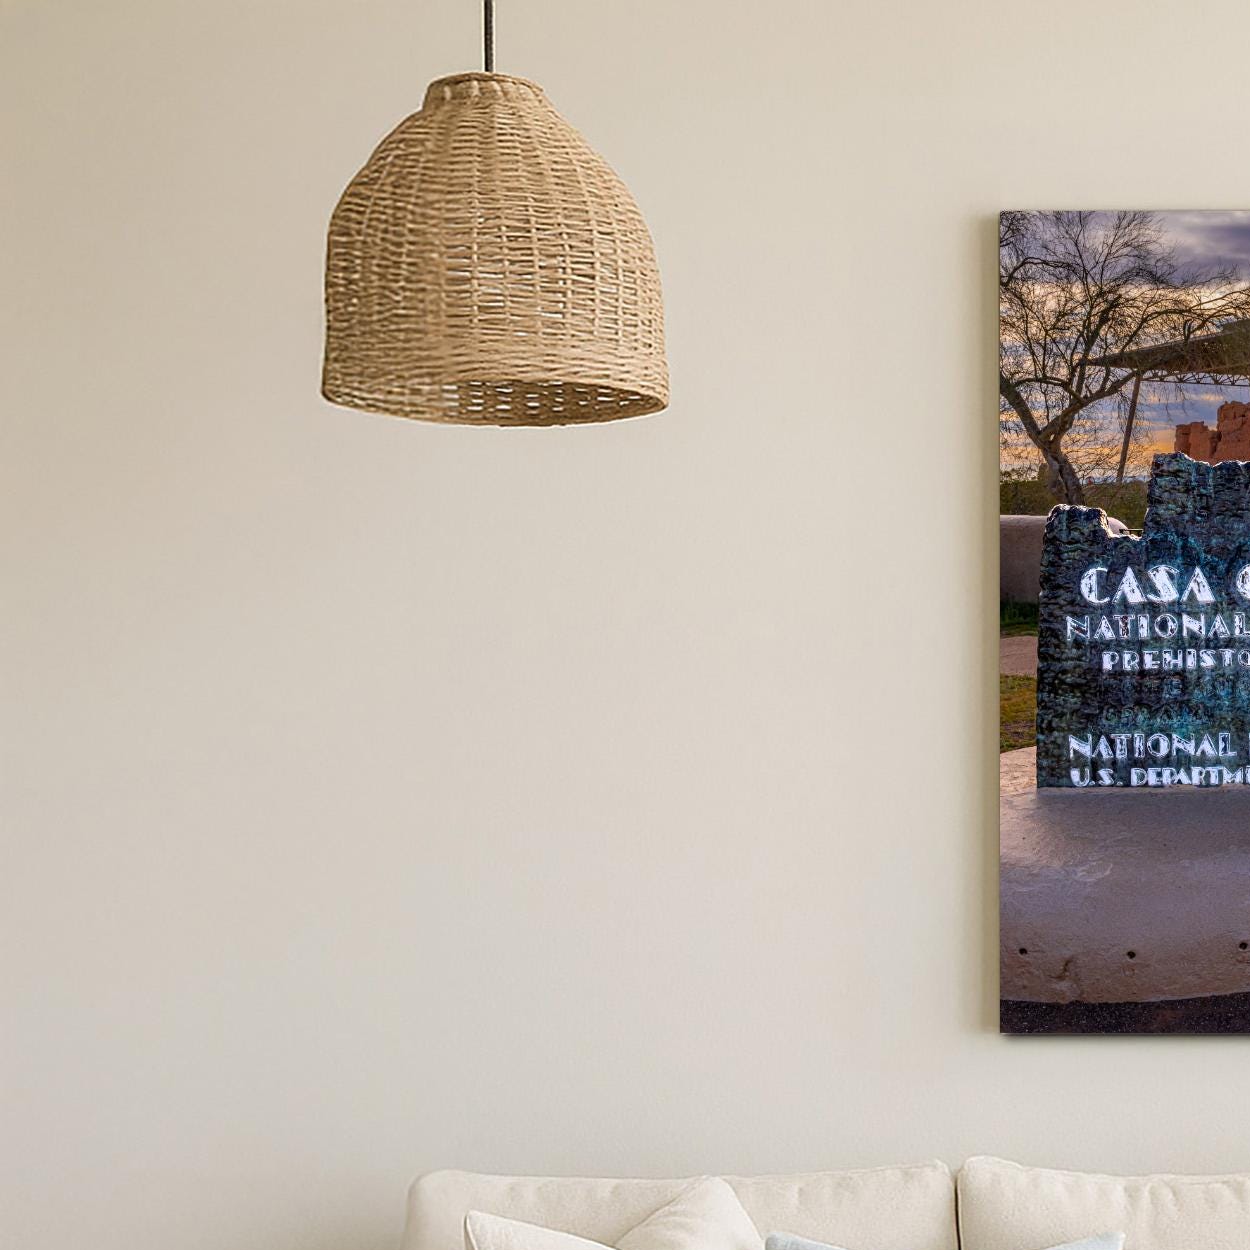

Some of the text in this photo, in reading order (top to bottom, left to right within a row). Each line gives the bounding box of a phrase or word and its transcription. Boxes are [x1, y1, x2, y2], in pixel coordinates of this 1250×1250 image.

[1080, 564, 1215, 603] CASA
[1069, 733, 1237, 758] NATIONAL
[1070, 767, 1123, 786] U.S.
